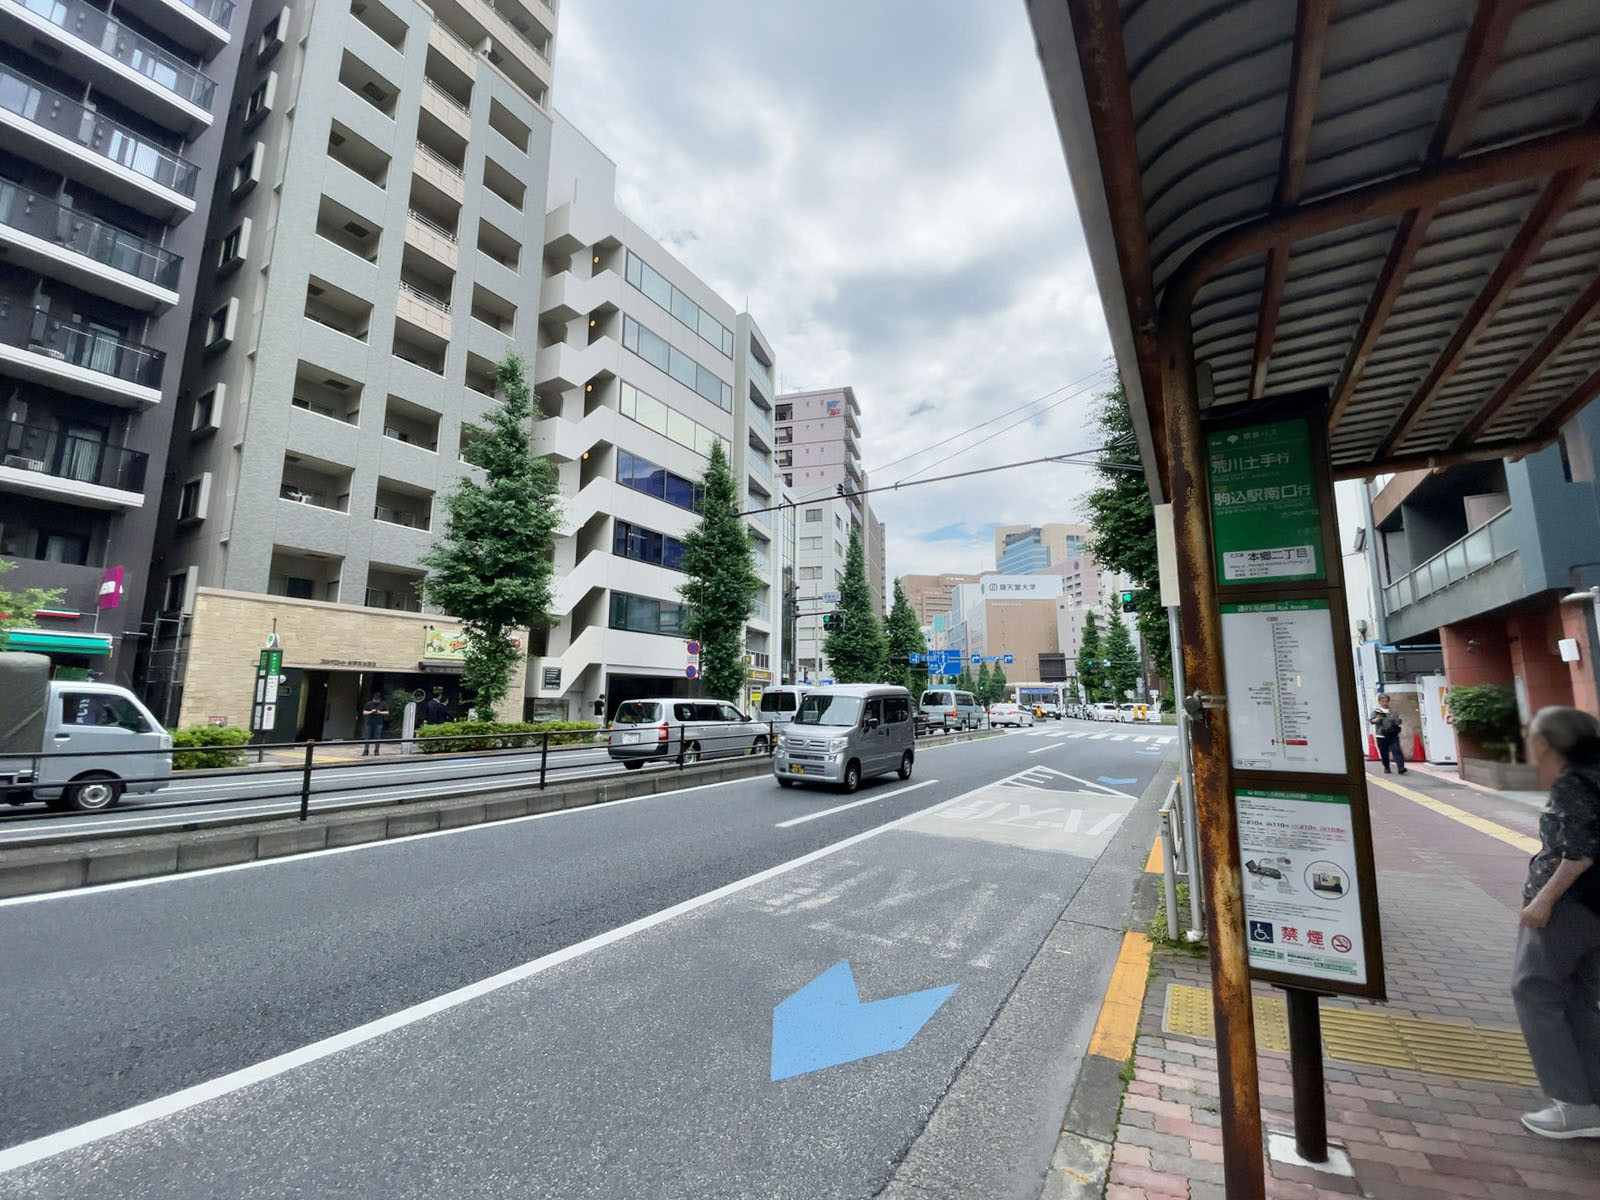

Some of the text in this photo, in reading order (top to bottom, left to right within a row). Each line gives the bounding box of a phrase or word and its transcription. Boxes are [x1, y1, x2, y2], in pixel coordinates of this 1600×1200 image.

[1211, 452, 1290, 474] 荒川土手行
[1214, 484, 1312, 506] 駒込駅南口行
[1247, 548, 1308, 561] 本郷二丁目
[1281, 926, 1324, 946] 禁煙
